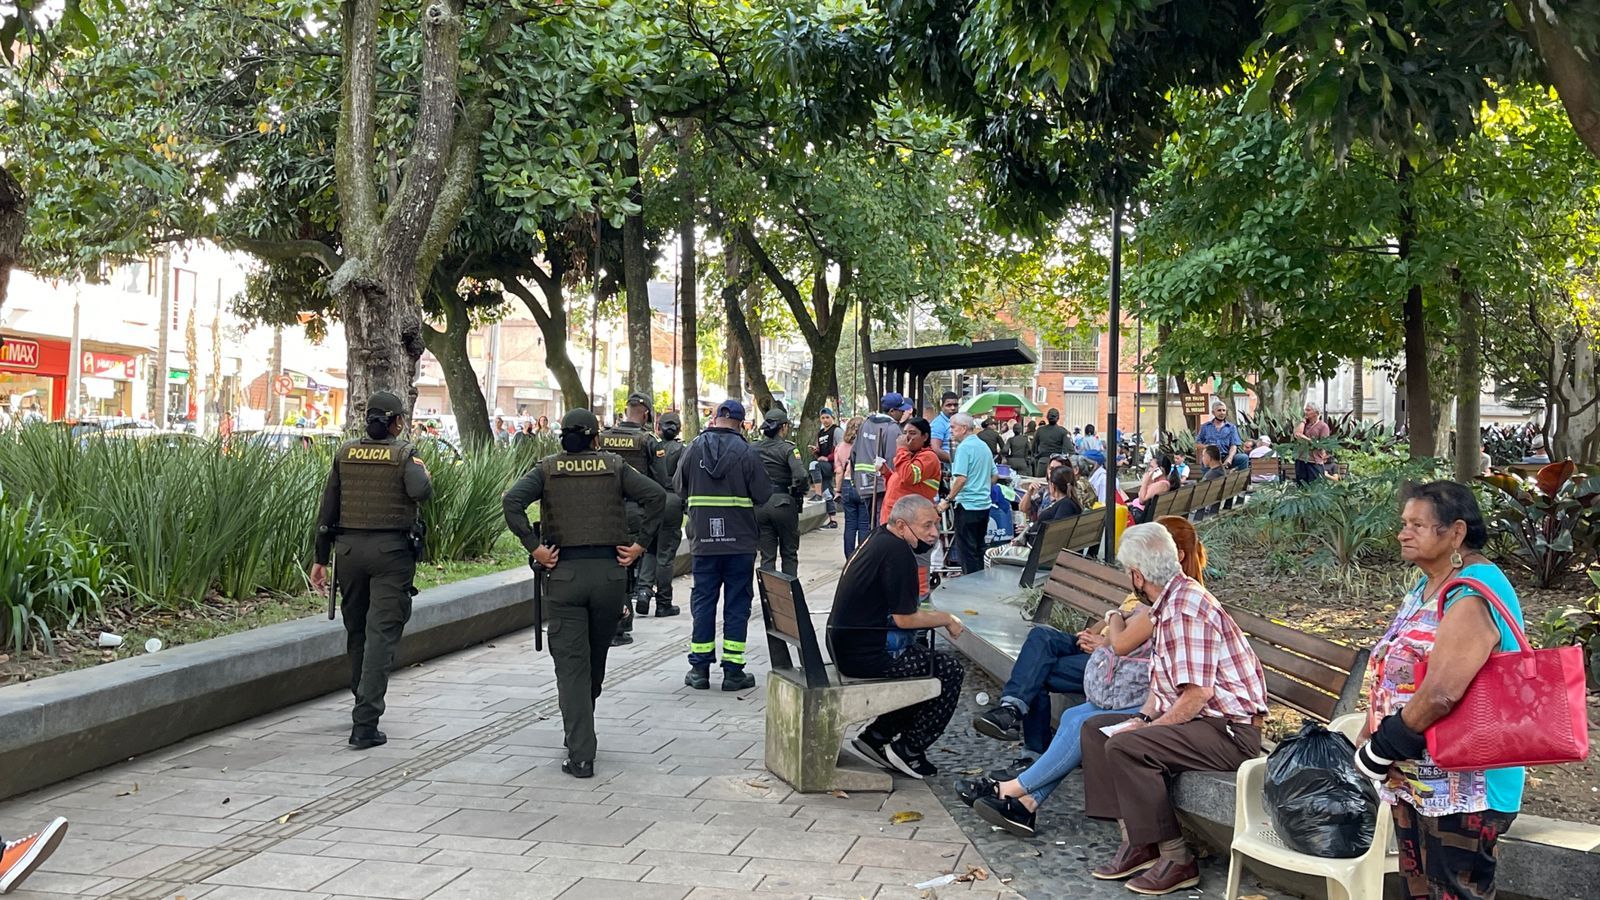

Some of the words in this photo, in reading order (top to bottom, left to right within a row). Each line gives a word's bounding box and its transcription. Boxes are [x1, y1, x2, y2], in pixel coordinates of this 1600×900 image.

[603, 437, 634, 448] POLICIA
[347, 447, 391, 461] POLICIA
[556, 458, 607, 473] POLICIA
